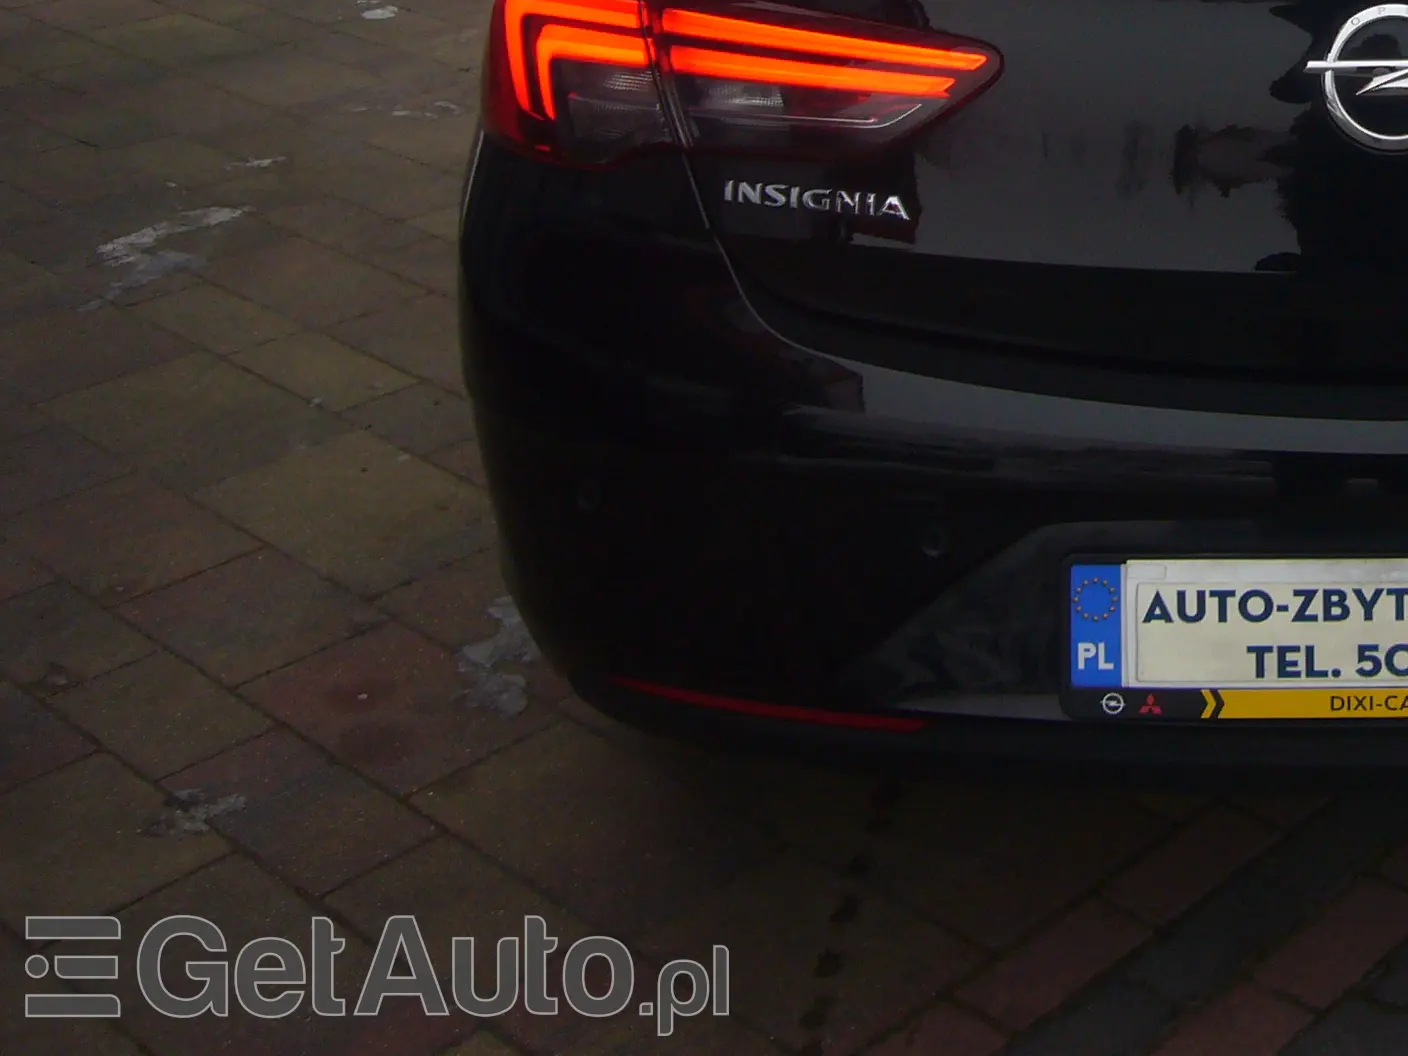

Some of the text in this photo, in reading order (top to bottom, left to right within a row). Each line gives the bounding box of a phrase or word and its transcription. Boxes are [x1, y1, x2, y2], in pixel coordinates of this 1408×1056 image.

[724, 179, 911, 221] INSIGNIA
[1077, 642, 1115, 671] PL
[1246, 644, 1342, 679] TEL.
